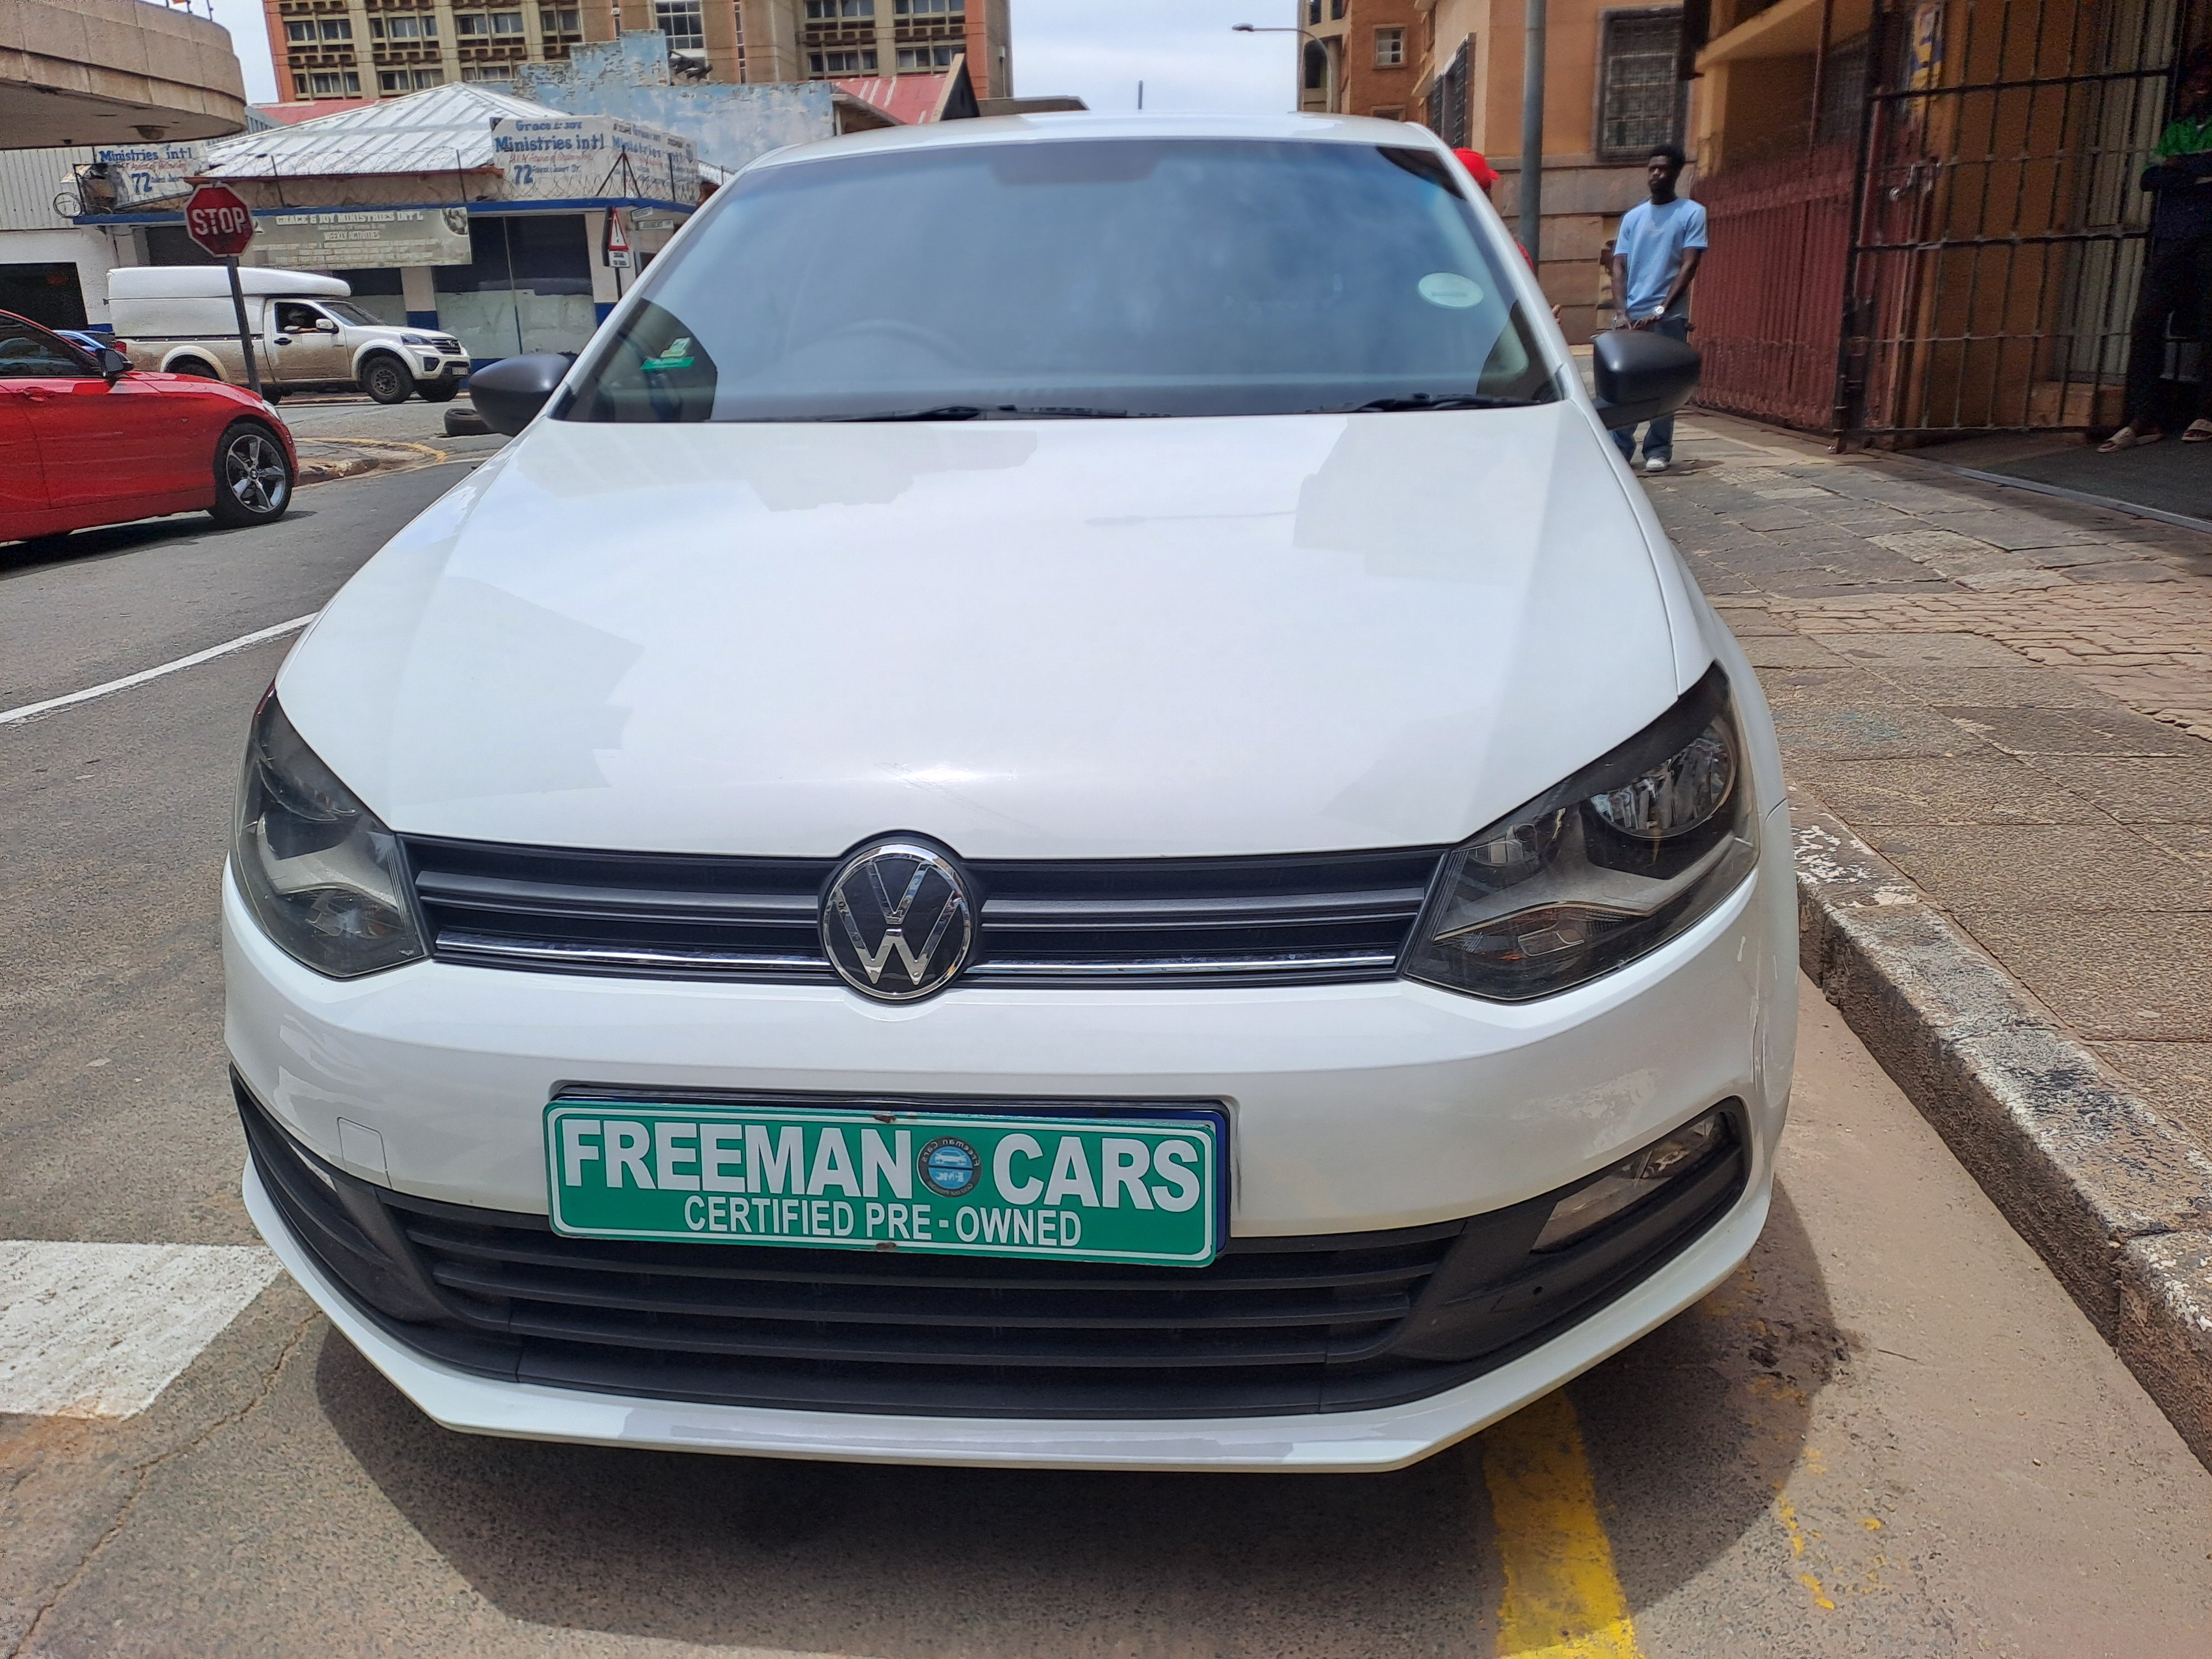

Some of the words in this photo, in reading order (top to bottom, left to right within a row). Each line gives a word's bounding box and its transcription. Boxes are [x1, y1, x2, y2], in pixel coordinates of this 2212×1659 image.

[494, 134, 572, 153] Ministries
[99, 149, 159, 162] Ministries
[131, 172, 153, 194] 72
[513, 164, 534, 185] 72
[192, 207, 246, 236] STOP
[276, 214, 309, 226] GRACE
[319, 213, 336, 224] JOY
[337, 212, 395, 223] MINISTRIES
[324, 231, 347, 241] WEEKLY
[348, 230, 380, 239] ACTIVITIES
[563, 1118, 912, 1199] FREEMAN
[993, 1133, 1201, 1212] CARS
[684, 1194, 853, 1238] CERTIFIED
